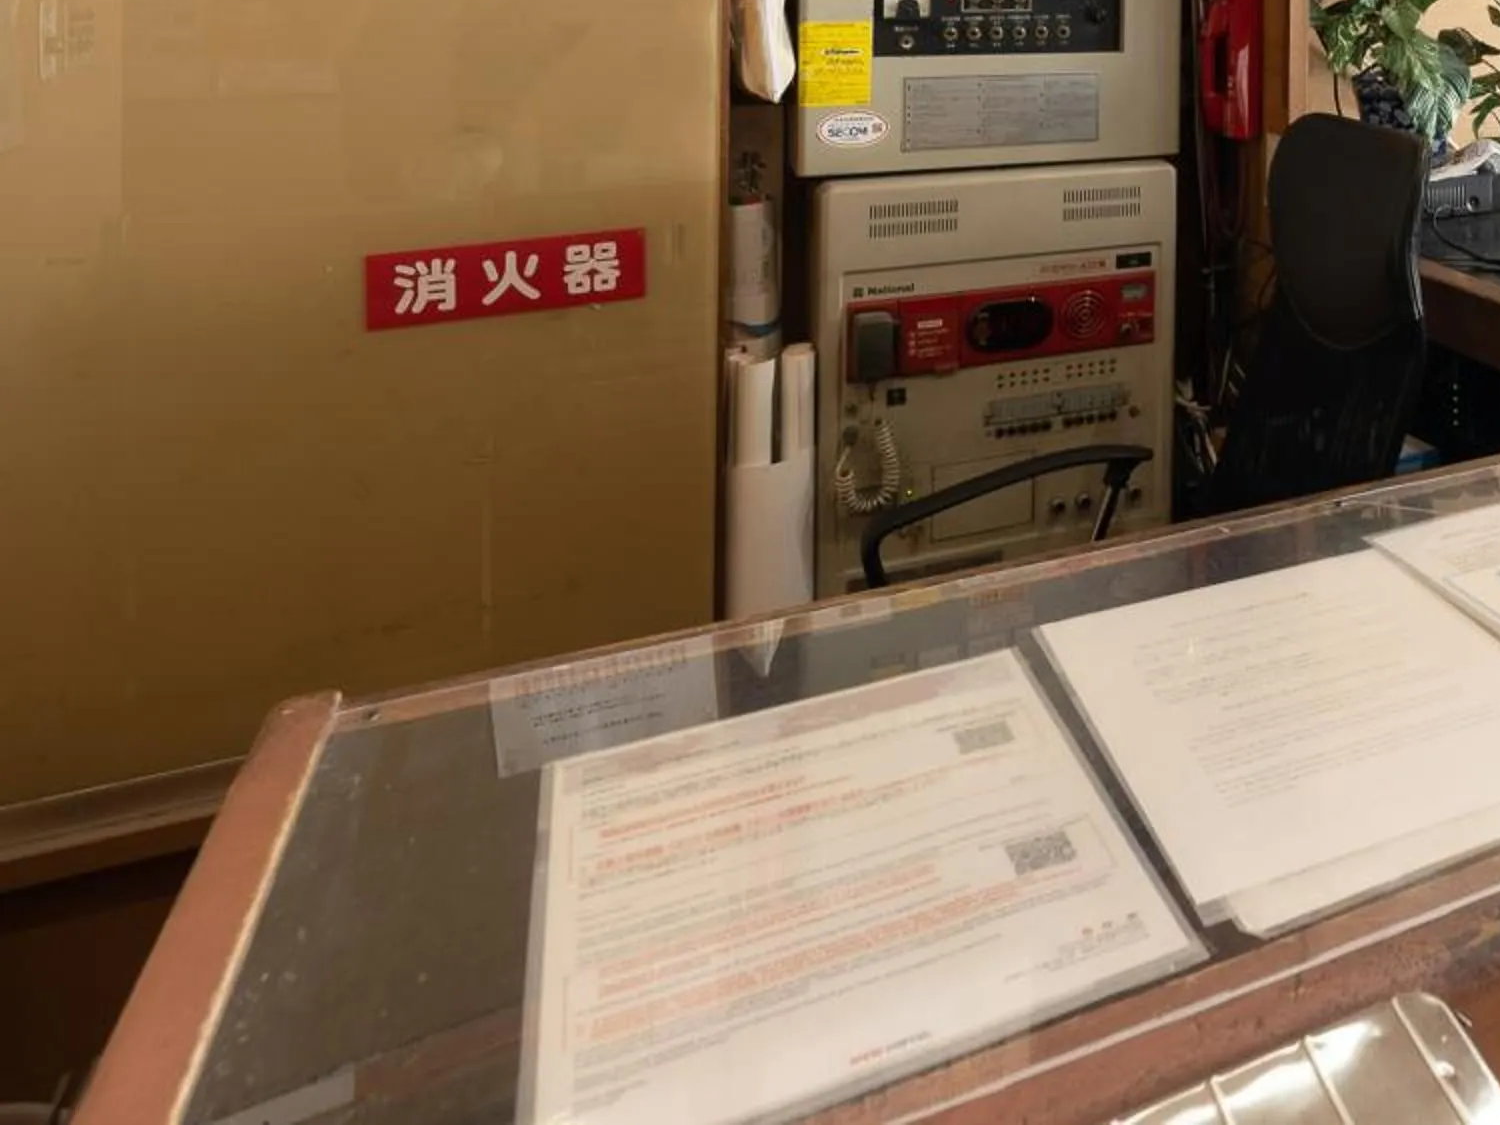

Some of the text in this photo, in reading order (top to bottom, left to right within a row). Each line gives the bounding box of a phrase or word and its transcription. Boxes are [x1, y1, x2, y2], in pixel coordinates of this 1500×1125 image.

[393, 240, 621, 315] 消火器
[867, 282, 915, 295] National
